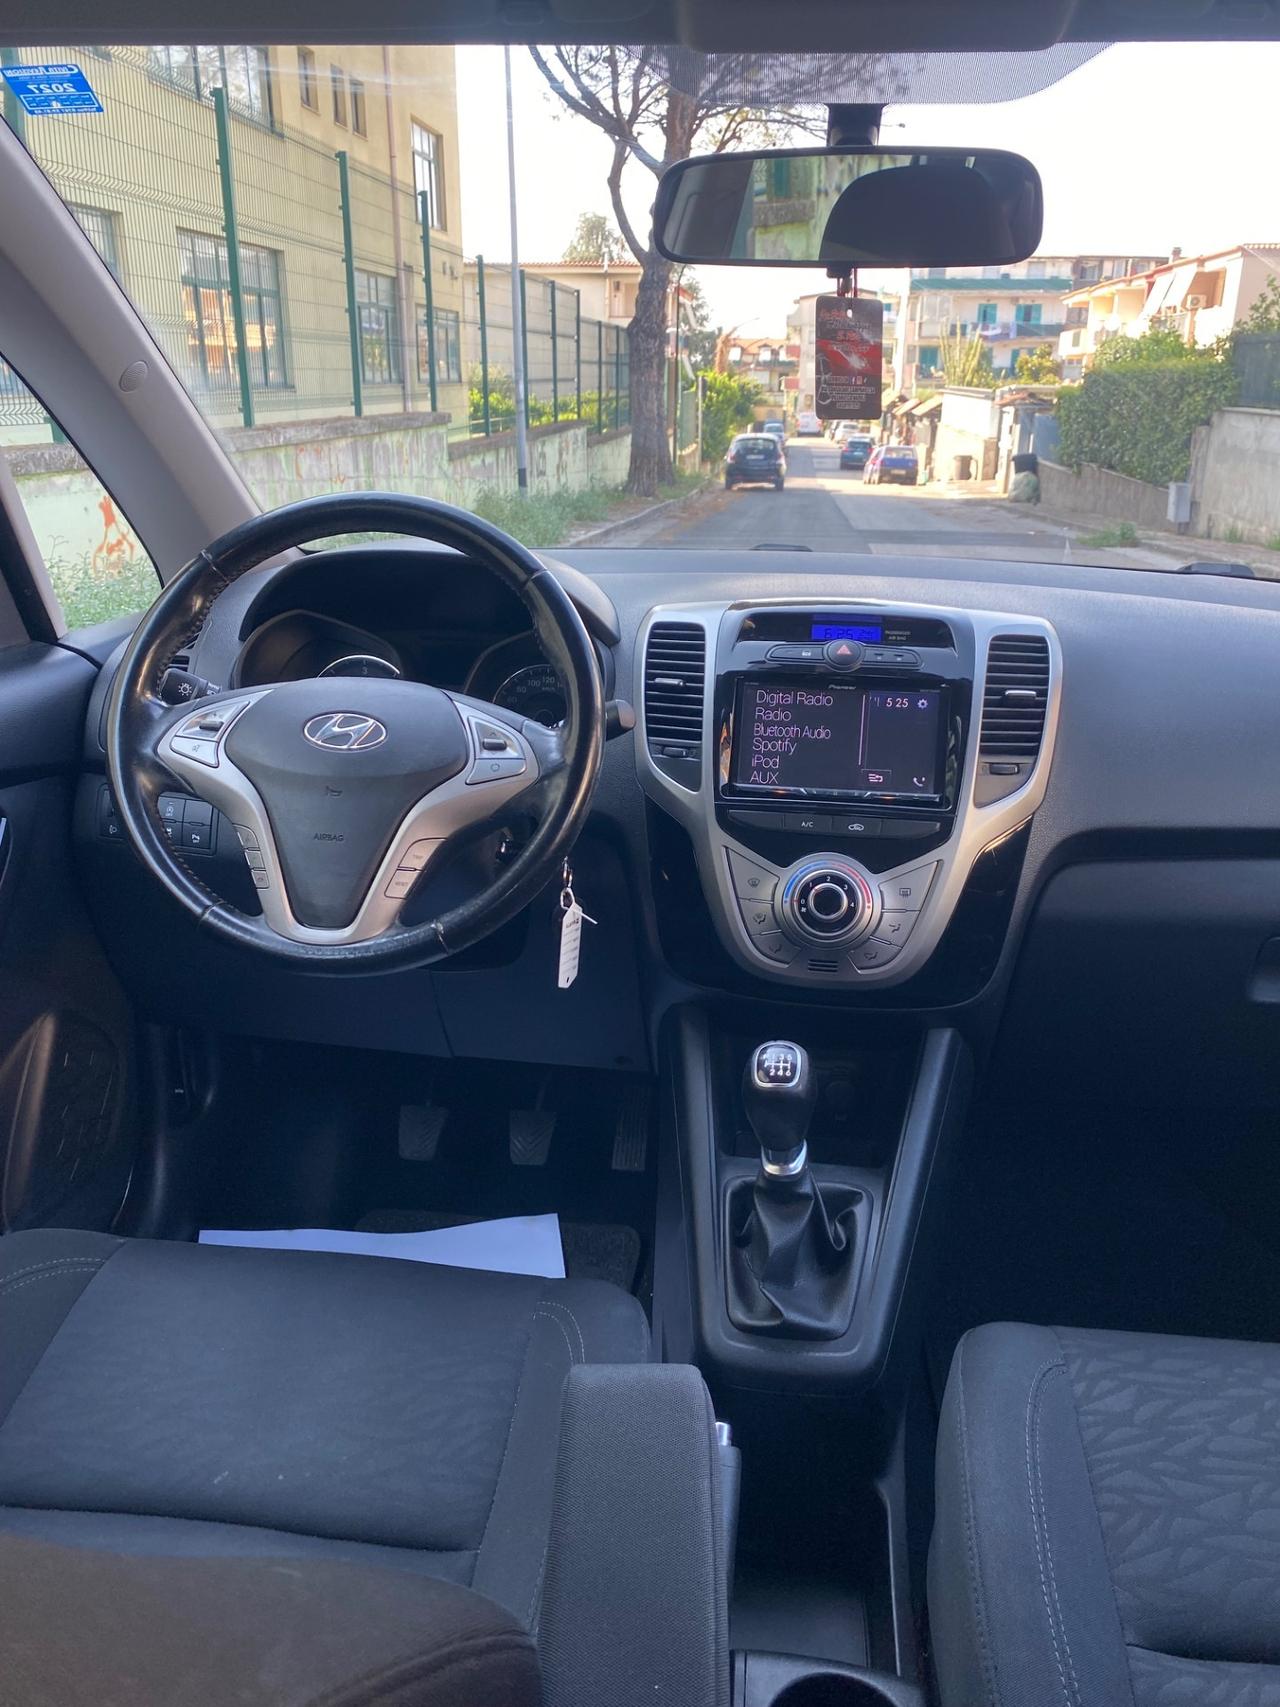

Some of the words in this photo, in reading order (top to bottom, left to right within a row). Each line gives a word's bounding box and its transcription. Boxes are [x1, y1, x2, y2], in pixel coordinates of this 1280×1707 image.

[756, 690, 794, 706] Digital
[797, 692, 834, 706] Radio
[755, 707, 792, 721] Radio
[753, 722, 800, 737] Bluetooth
[802, 725, 831, 739] Audio
[752, 737, 797, 755] Spotify
[751, 754, 780, 769] iPod
[750, 771, 779, 784] AUX
[313, 832, 344, 841] AIRBAG
